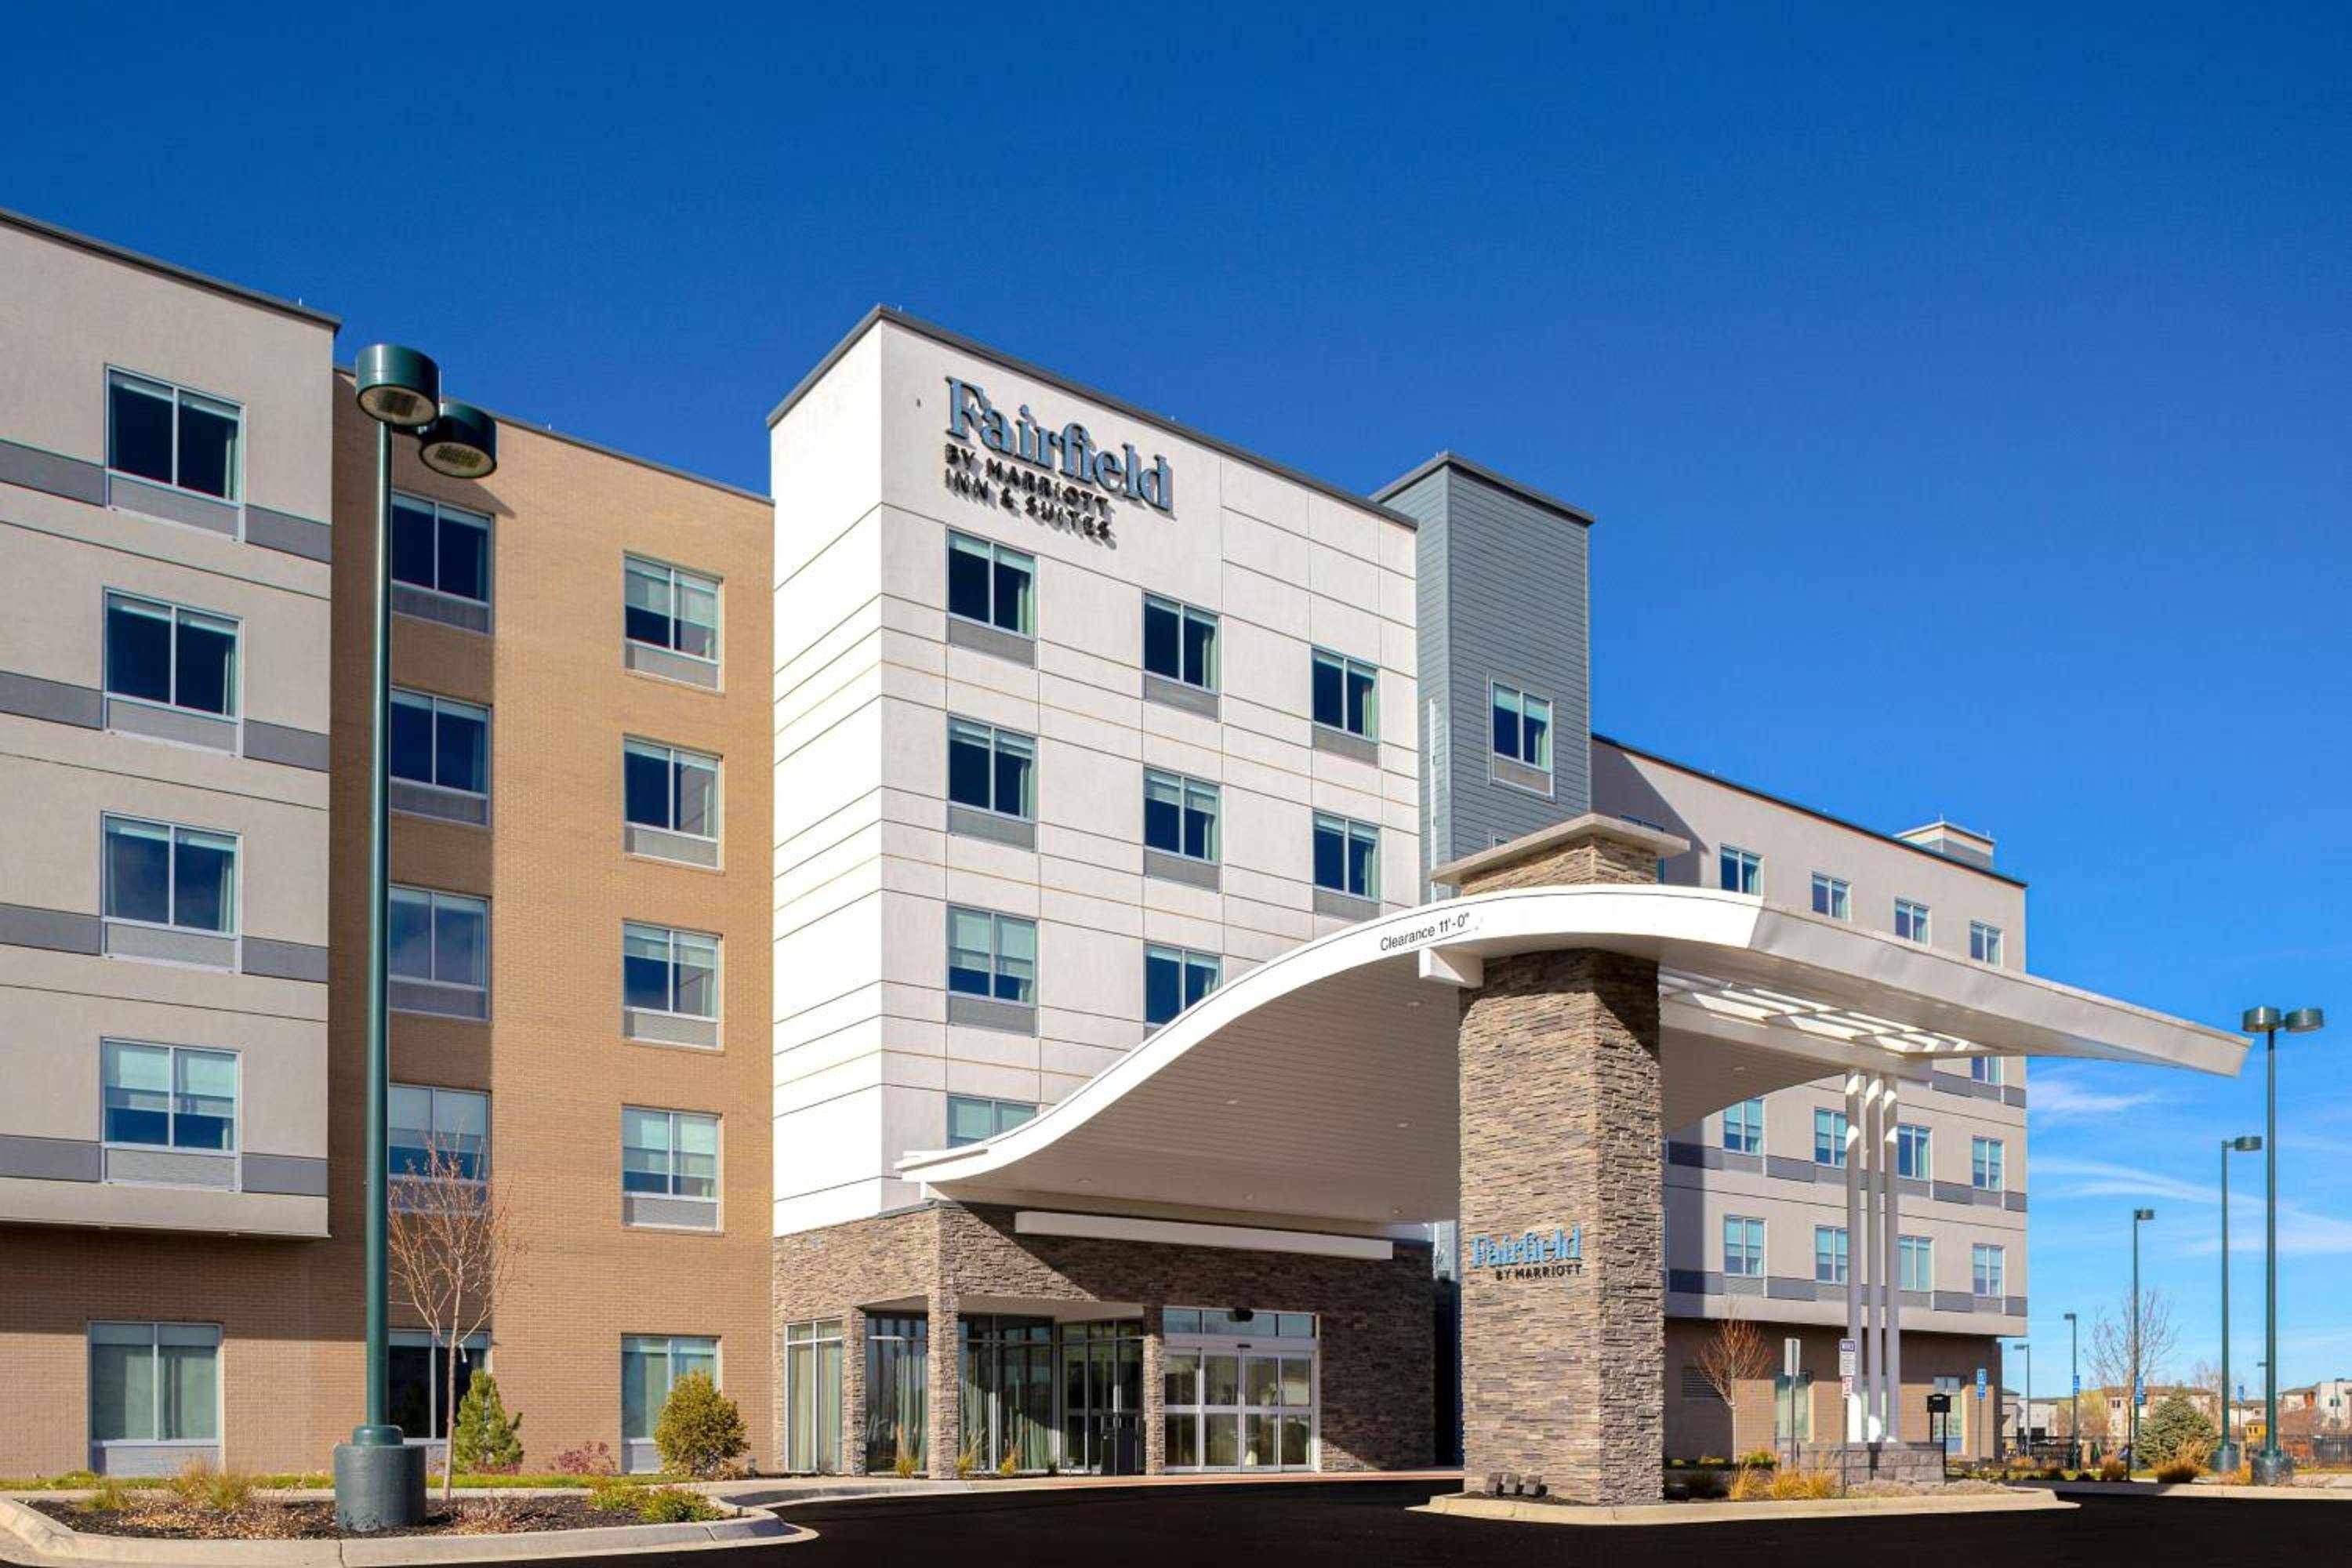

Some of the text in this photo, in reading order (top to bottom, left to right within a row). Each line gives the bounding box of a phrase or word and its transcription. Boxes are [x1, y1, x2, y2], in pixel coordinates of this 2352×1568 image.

[945, 376, 1174, 512] Fairfield
[946, 443, 1109, 516] BY MARRIOTT
[946, 467, 1109, 541] INN & SUITES
[1380, 926, 1436, 951] Clearance
[1472, 1228, 1582, 1269] Fairfield
[1495, 1263, 1583, 1281] BY MARRIOTT
